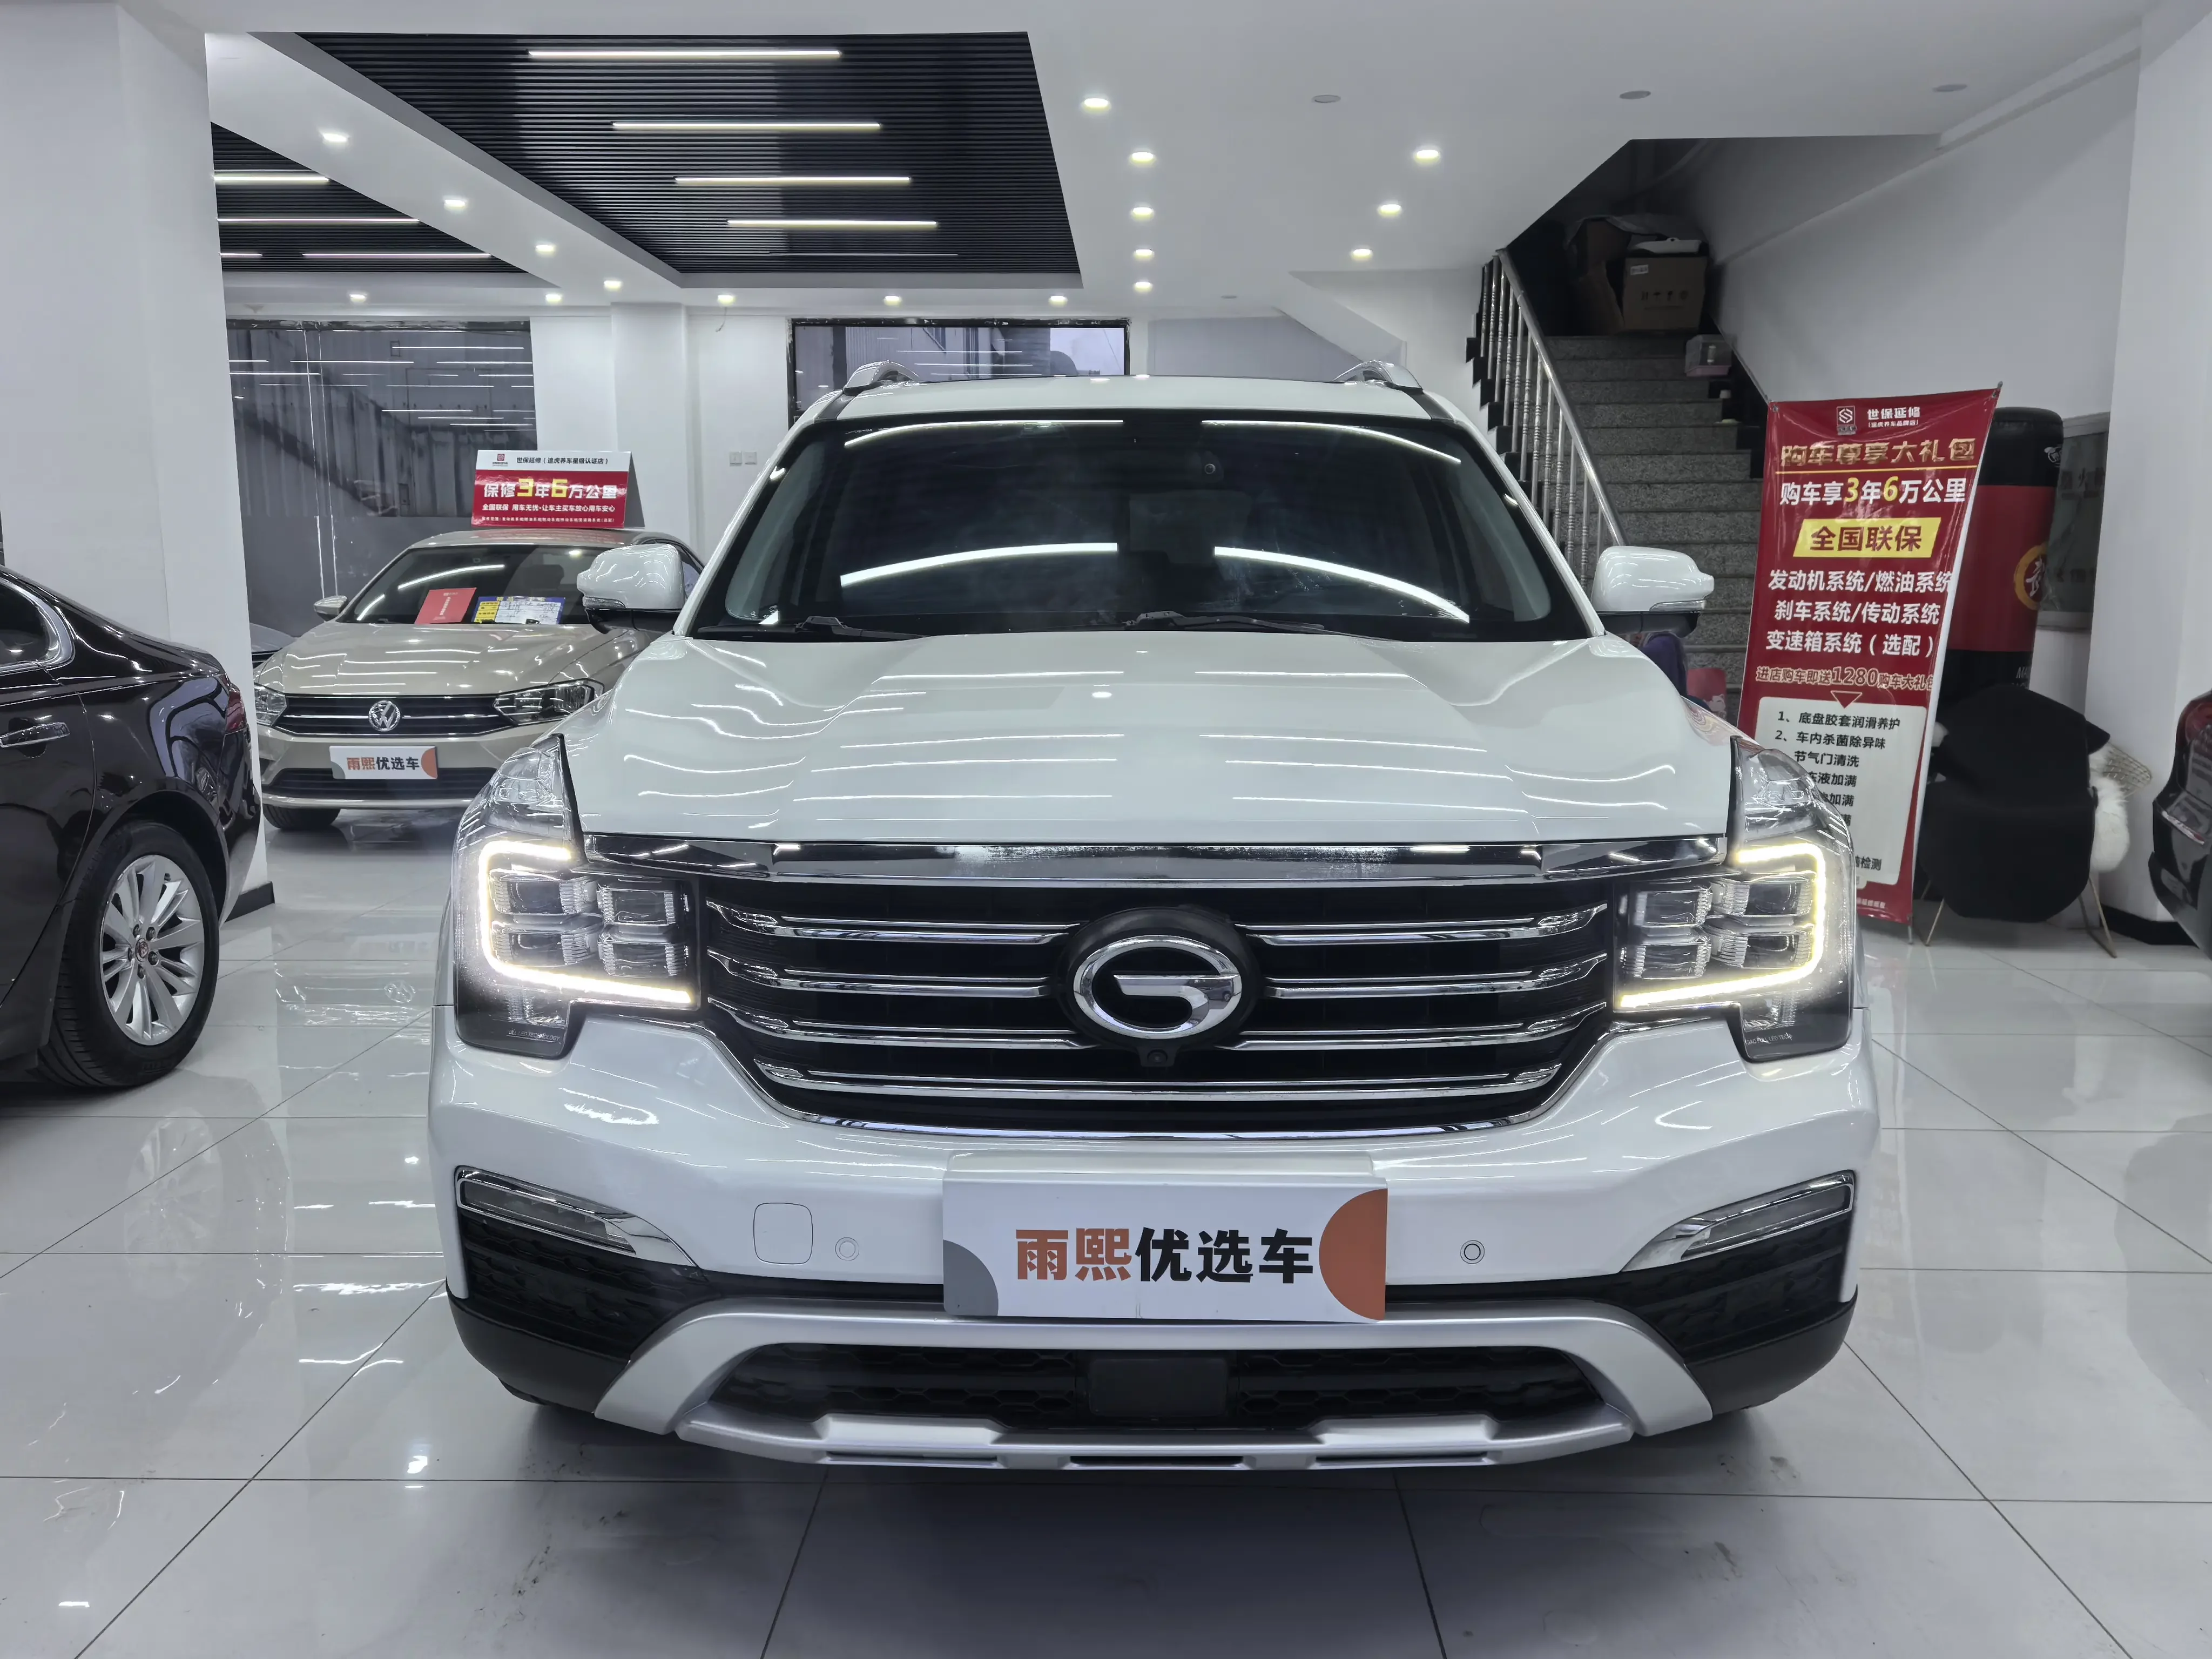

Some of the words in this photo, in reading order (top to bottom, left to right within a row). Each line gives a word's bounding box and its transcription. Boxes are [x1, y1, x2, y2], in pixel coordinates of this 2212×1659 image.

[1867, 407, 1920, 420] 世保延修
[483, 478, 617, 499] 保修3年6万公里
[1779, 476, 1967, 505] 购车享3年6万公里
[1810, 525, 1922, 552] 全国联保
[1773, 599, 1941, 625] 刹车系统/传动系统
[346, 756, 420, 770] 雨熙优选车
[1822, 792, 1854, 807] 加满
[1015, 1226, 1314, 1285] 雨熙优选车
